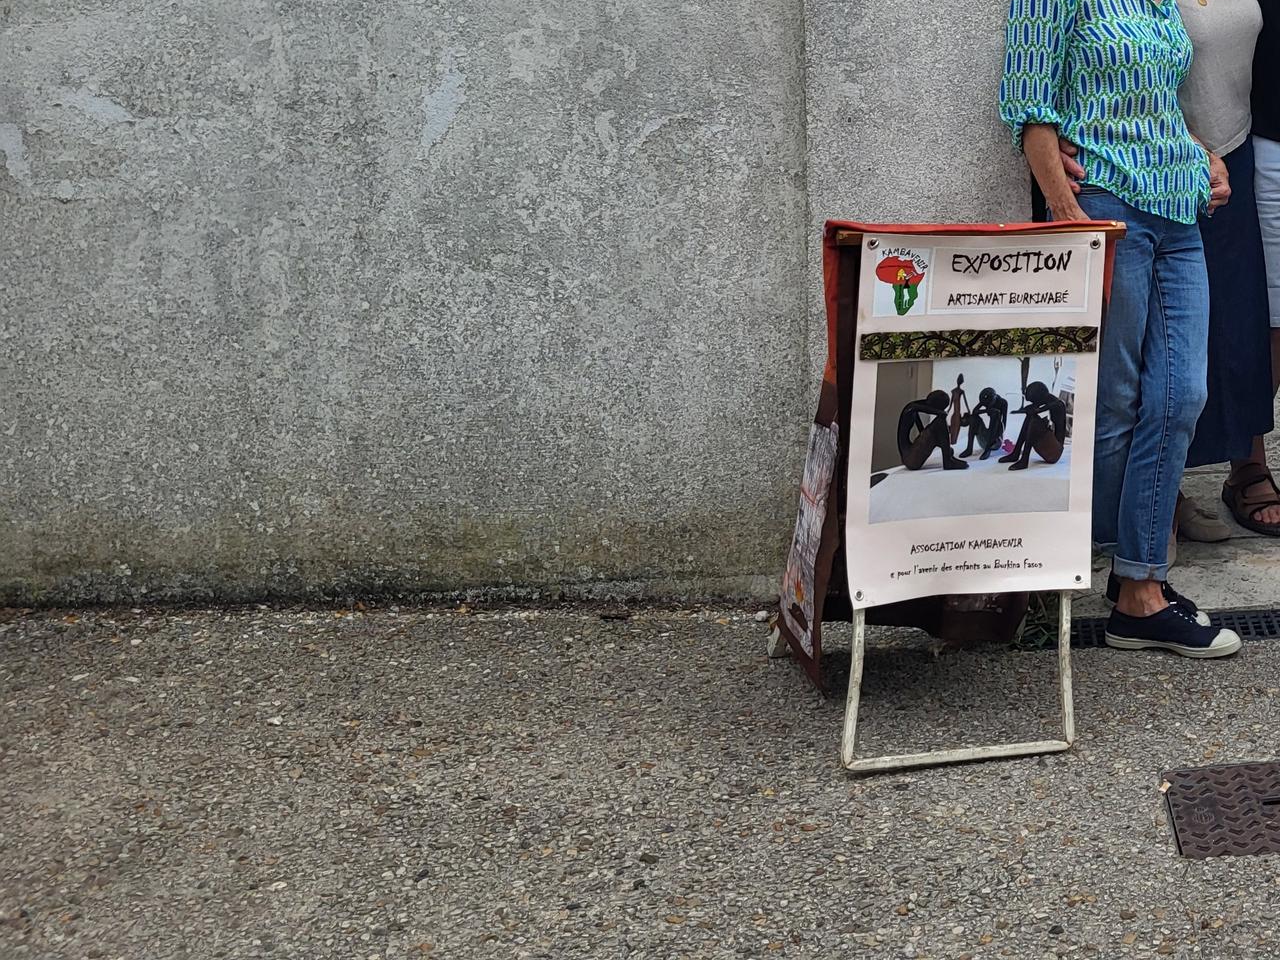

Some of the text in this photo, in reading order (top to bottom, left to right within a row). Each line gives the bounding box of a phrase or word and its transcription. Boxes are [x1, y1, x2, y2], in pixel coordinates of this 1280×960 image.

[881, 247, 928, 272] KAMBAVENIR
[951, 249, 1072, 274] EXPOSITION
[947, 289, 1070, 306] ARTISANAT BURKINABÉ
[910, 537, 1024, 555] ASSOCIATION KAMBAVENIR
[897, 569, 911, 580] pour
[913, 564, 938, 575] l'avenir
[940, 562, 953, 572] des
[954, 560, 981, 571] enfants
[993, 559, 1021, 569] Burkina
